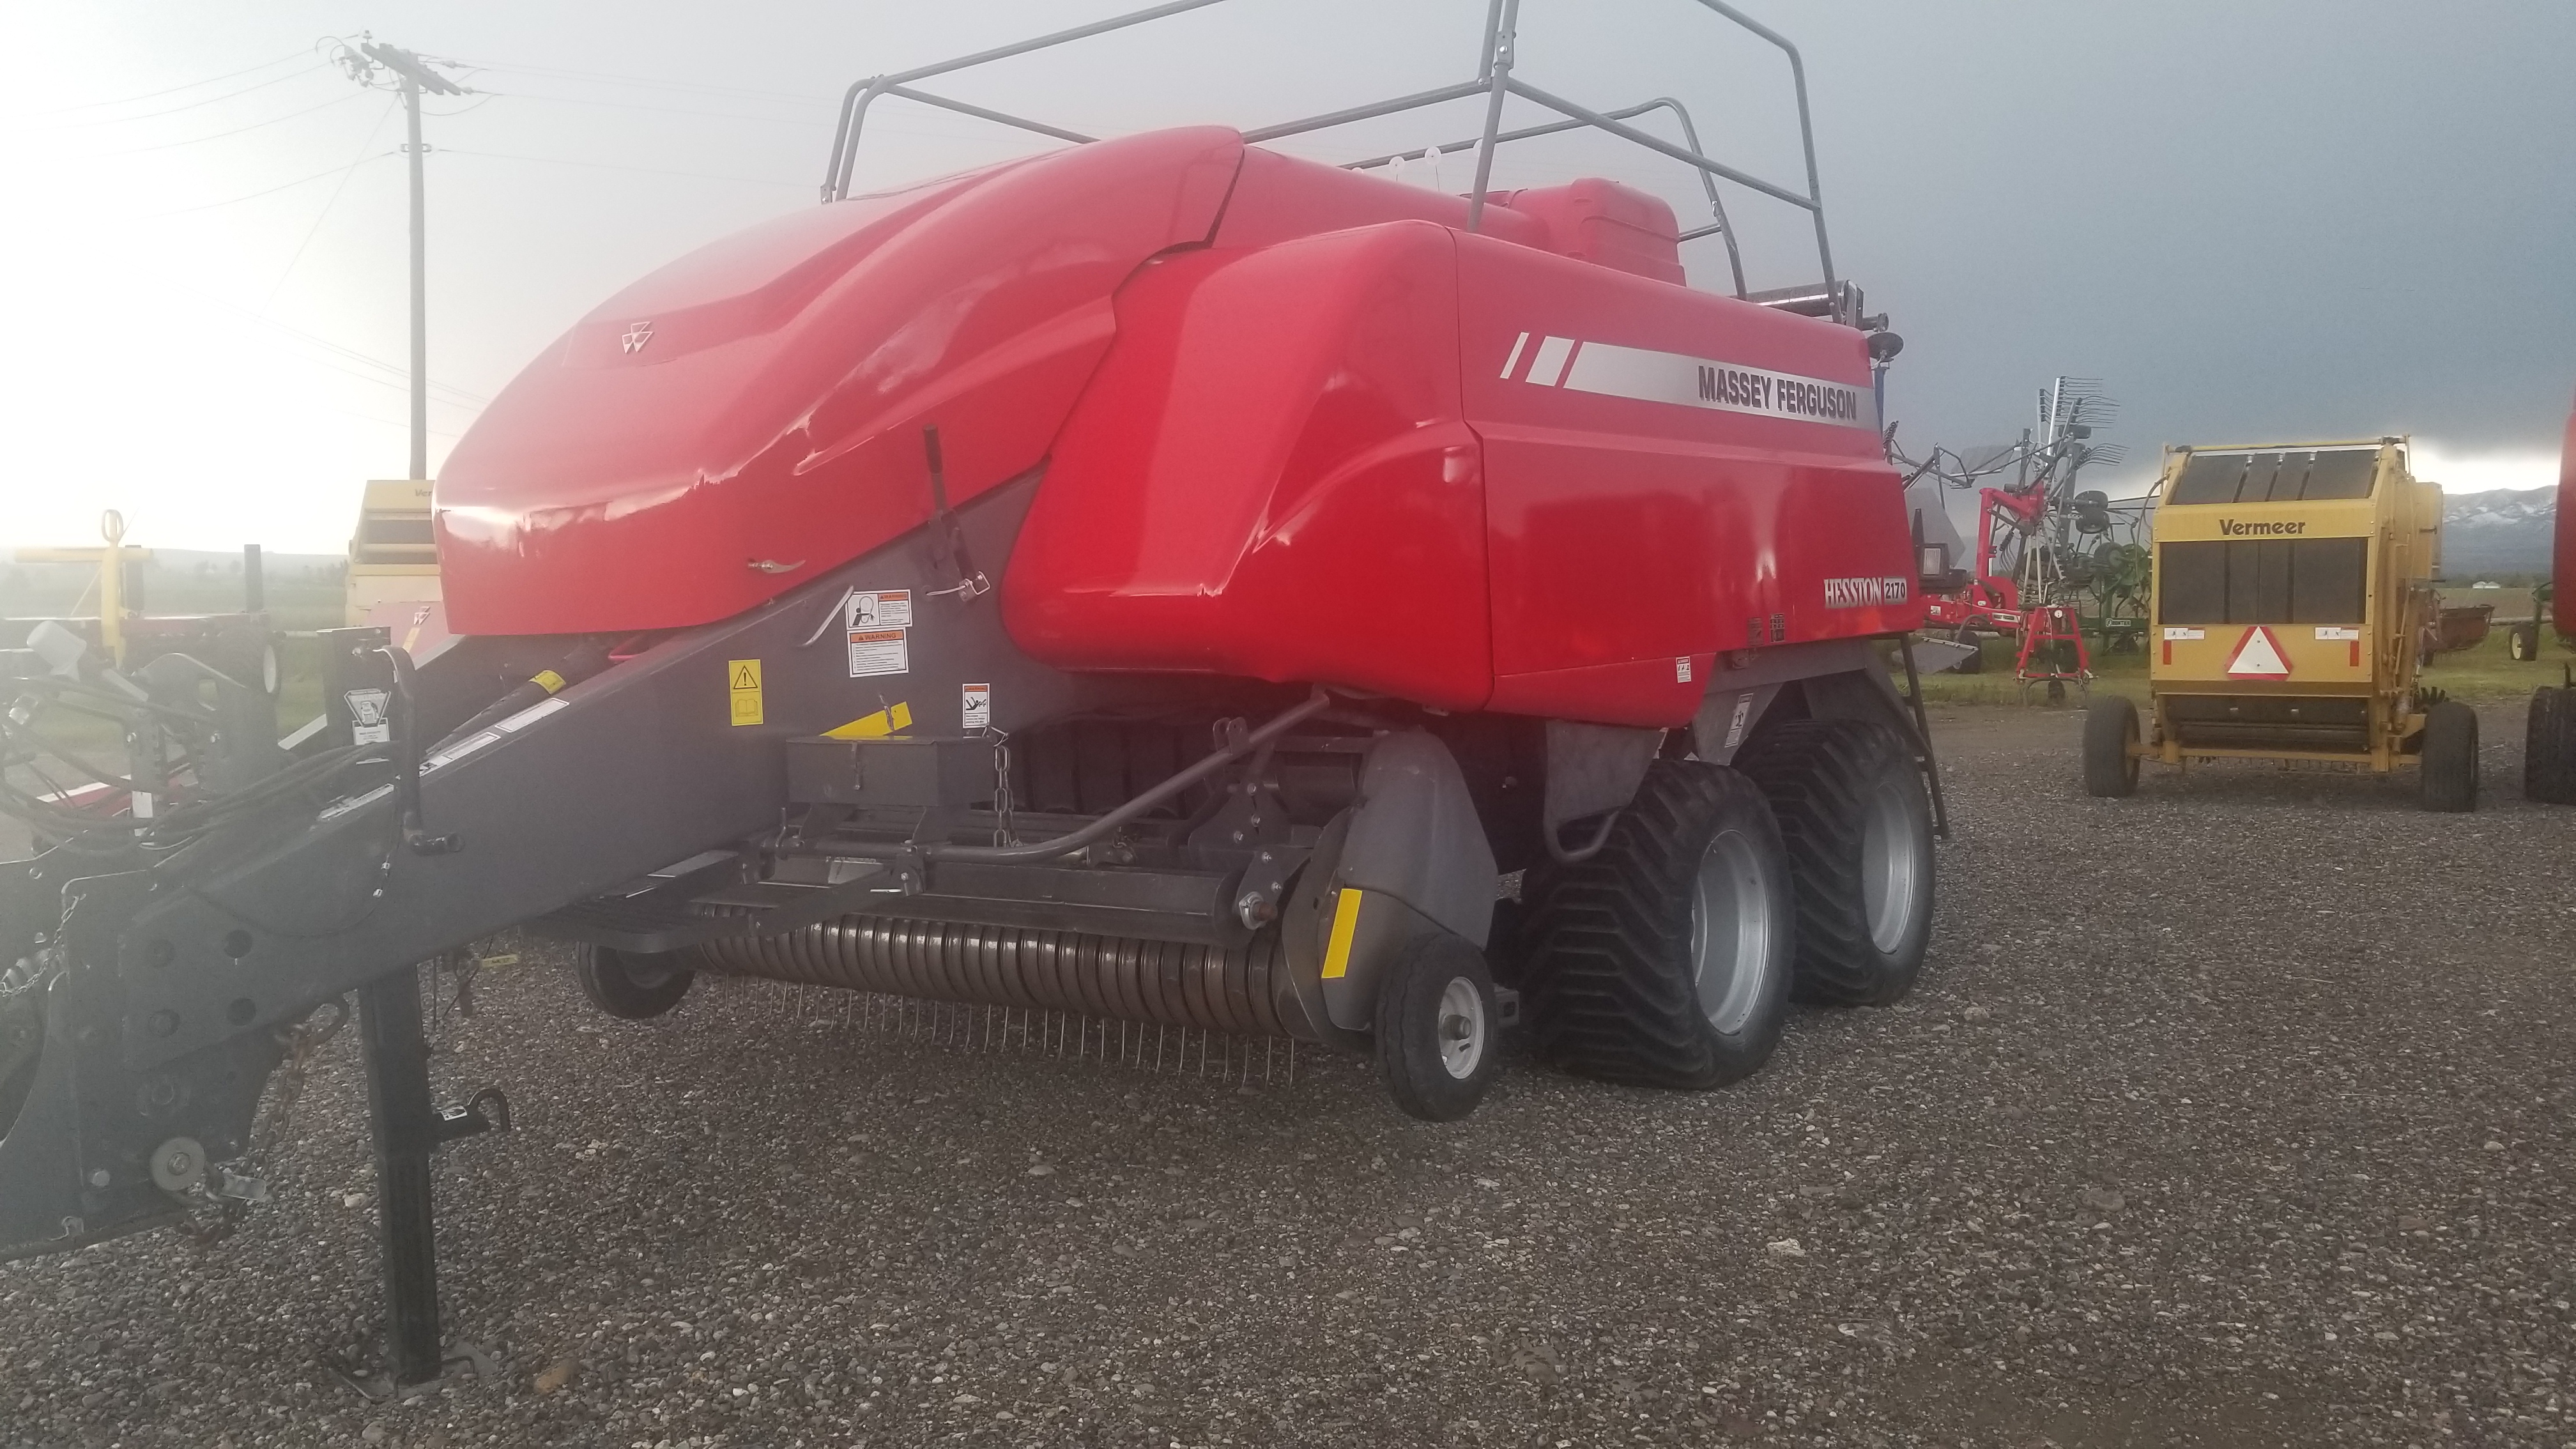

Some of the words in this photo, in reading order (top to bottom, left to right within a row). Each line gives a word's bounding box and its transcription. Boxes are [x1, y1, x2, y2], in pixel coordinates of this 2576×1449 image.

[1698, 365, 1772, 409] MASSEY
[1777, 379, 1857, 420] FERGUSON
[2220, 519, 2306, 535] Vermeer
[1823, 578, 1882, 608] HESSTON
[1885, 582, 1906, 599] 2170
[864, 632, 896, 641] WARNING
